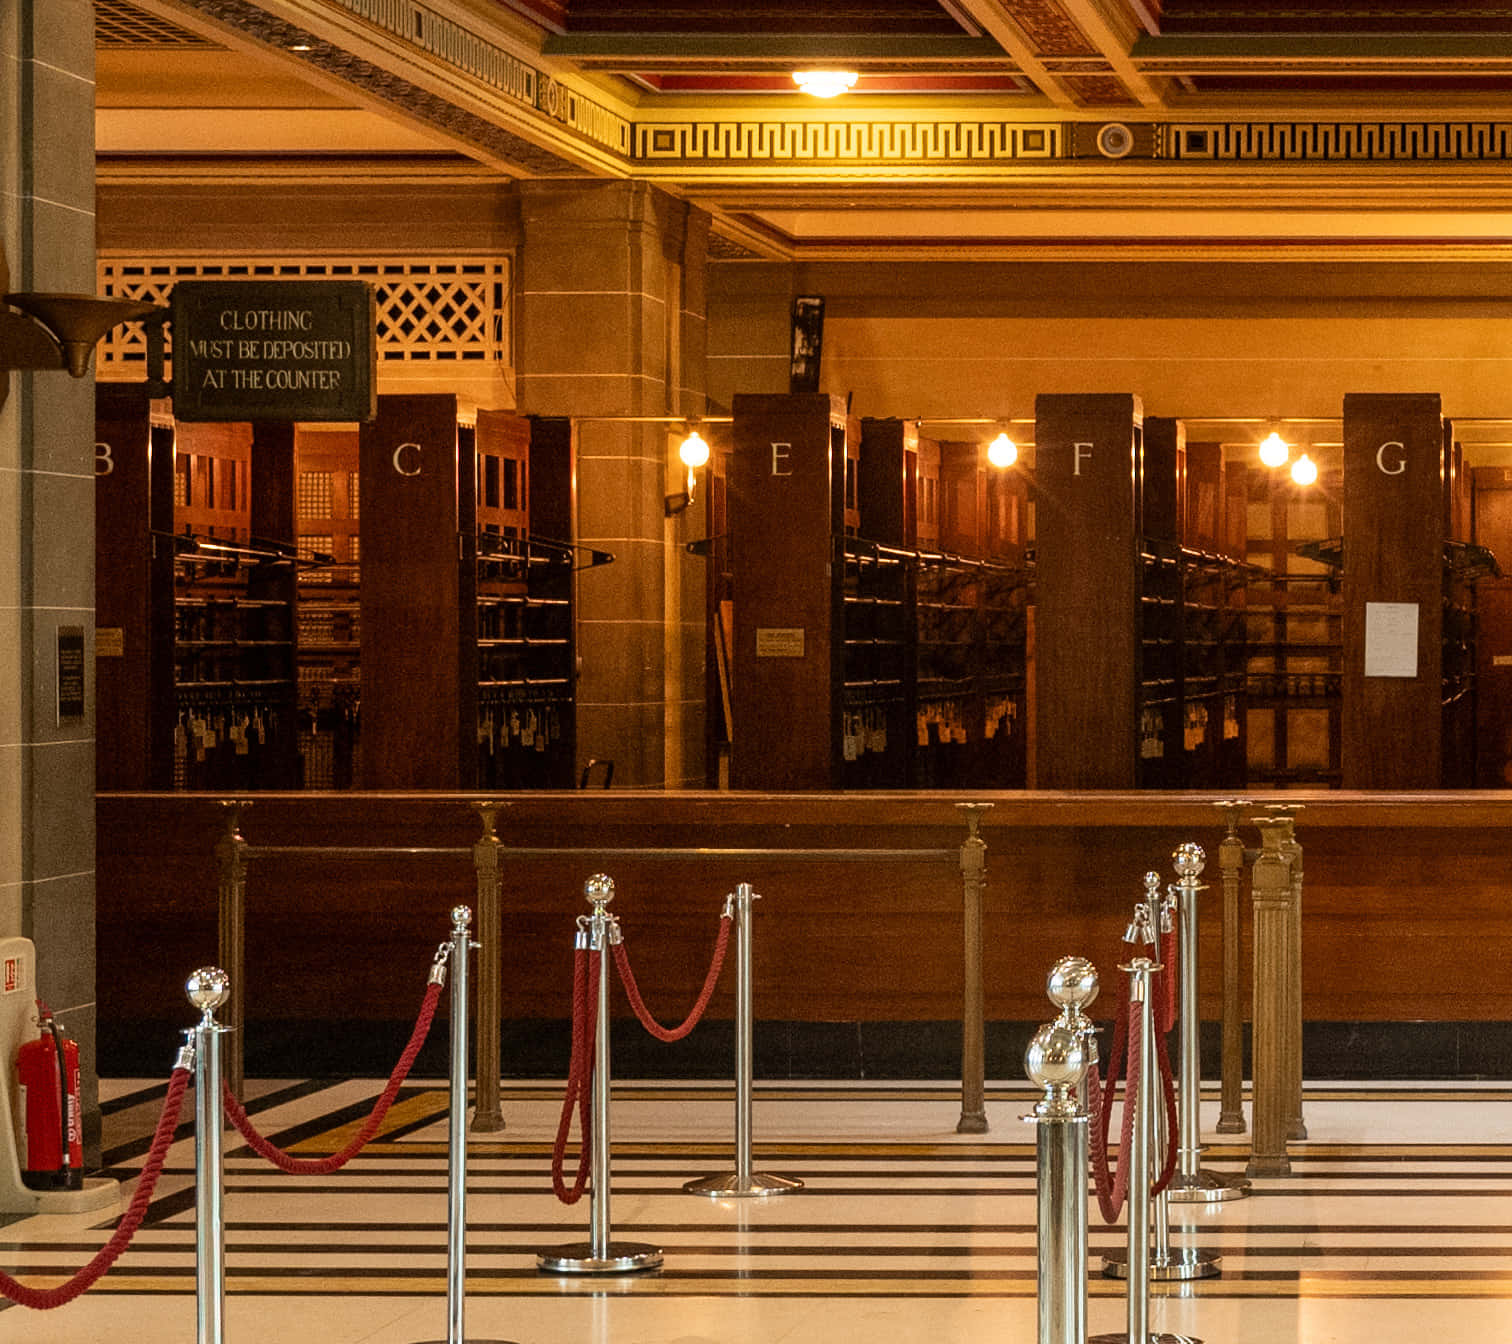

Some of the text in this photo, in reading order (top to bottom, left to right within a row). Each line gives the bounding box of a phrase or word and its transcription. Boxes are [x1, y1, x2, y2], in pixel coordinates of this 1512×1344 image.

[220, 310, 312, 331] CLOTHING
[189, 339, 351, 360] MUST BE DEPOSITED
[202, 369, 341, 390] AT THE COUNTER
[393, 442, 421, 476] C
[770, 442, 792, 476] E
[1072, 442, 1094, 476] F
[1376, 441, 1406, 475] G
